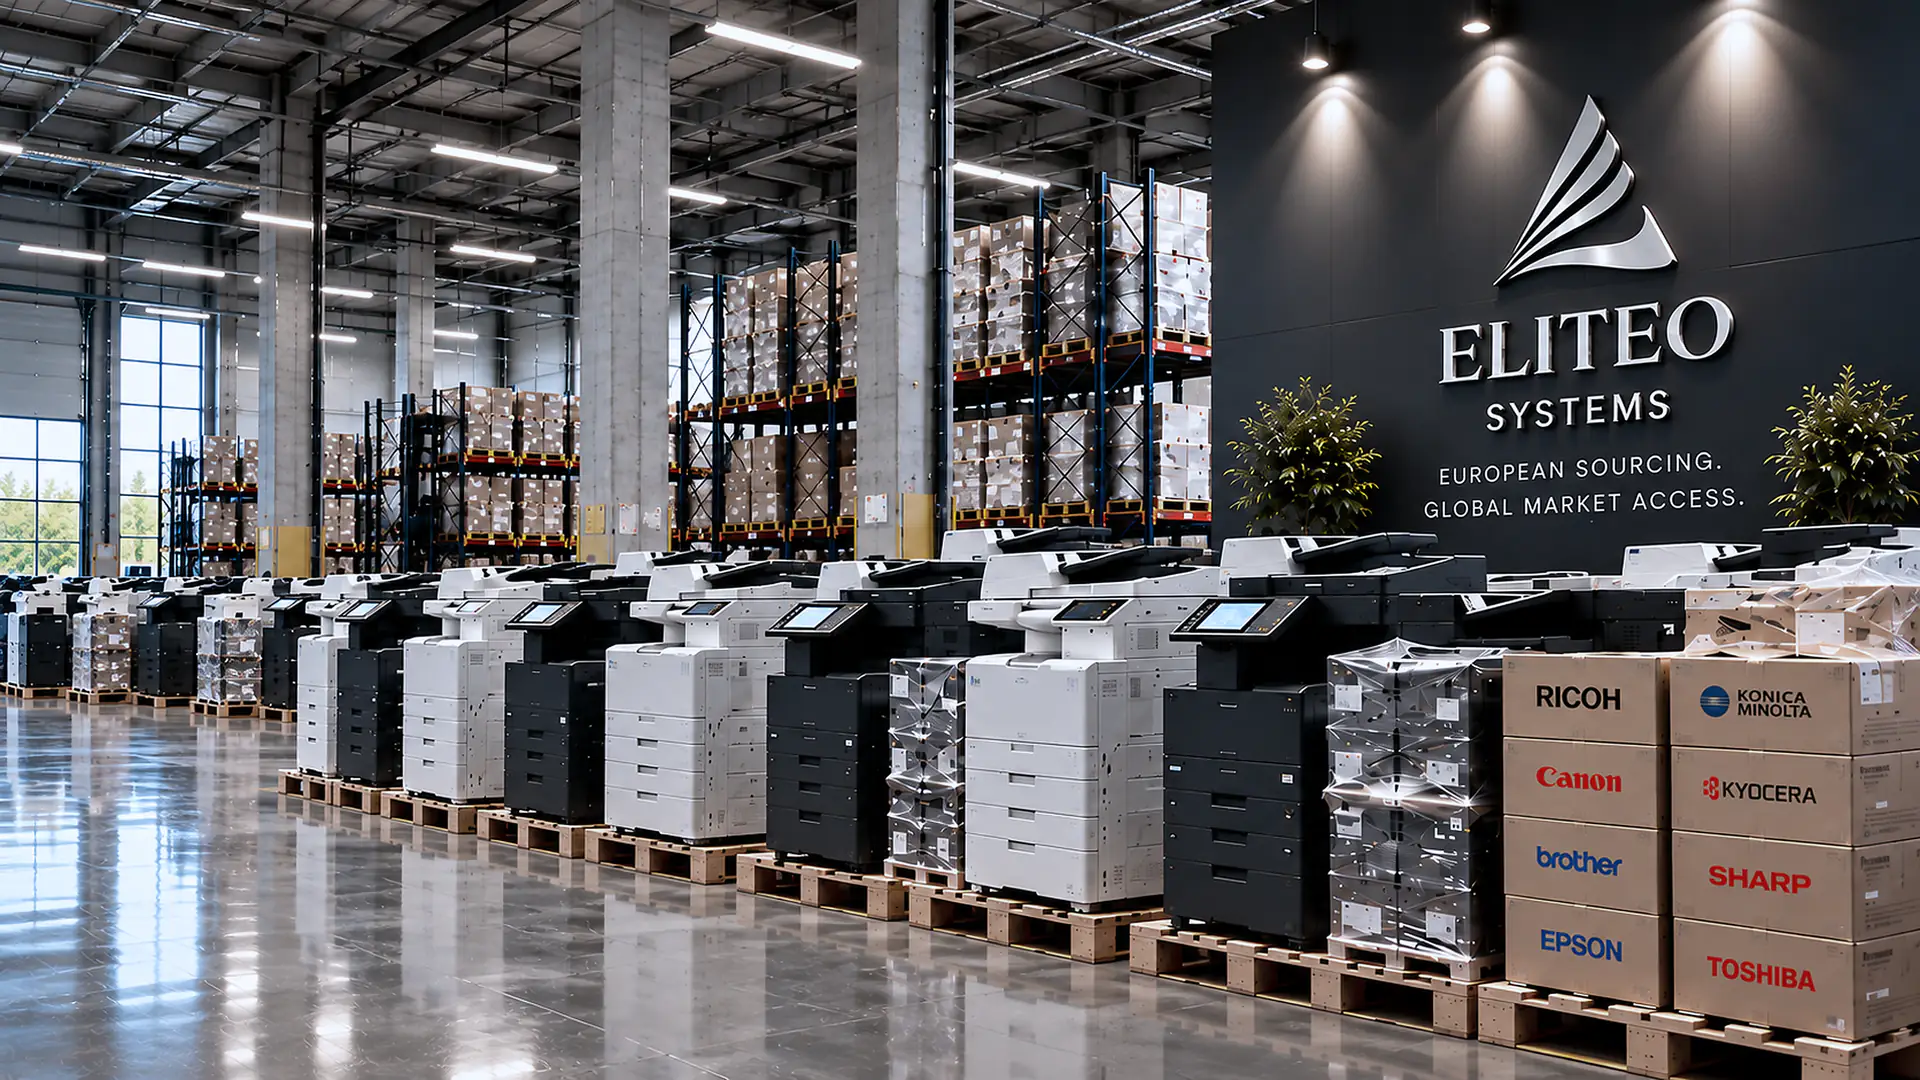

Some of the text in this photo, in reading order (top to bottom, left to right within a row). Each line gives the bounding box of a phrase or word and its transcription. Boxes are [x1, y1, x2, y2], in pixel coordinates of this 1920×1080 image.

[1439, 297, 1733, 383] ELITEO
[1487, 390, 1670, 430] SYSTEMS
[1440, 452, 1721, 485] EUROPEAN SOURCING.
[1425, 488, 1743, 518] GLOBAL MARKET ACCESS.
[1537, 685, 1620, 710] RICOH
[1738, 689, 1806, 705] KONICA
[1738, 703, 1812, 718] MINOLTA
[1536, 766, 1621, 792] Canon
[1723, 782, 1816, 804] KYOCERA
[1536, 846, 1622, 876] brother
[1710, 865, 1811, 894] SHARP
[1541, 930, 1622, 962] EPSON
[1707, 956, 1816, 992] TOSHIBA
